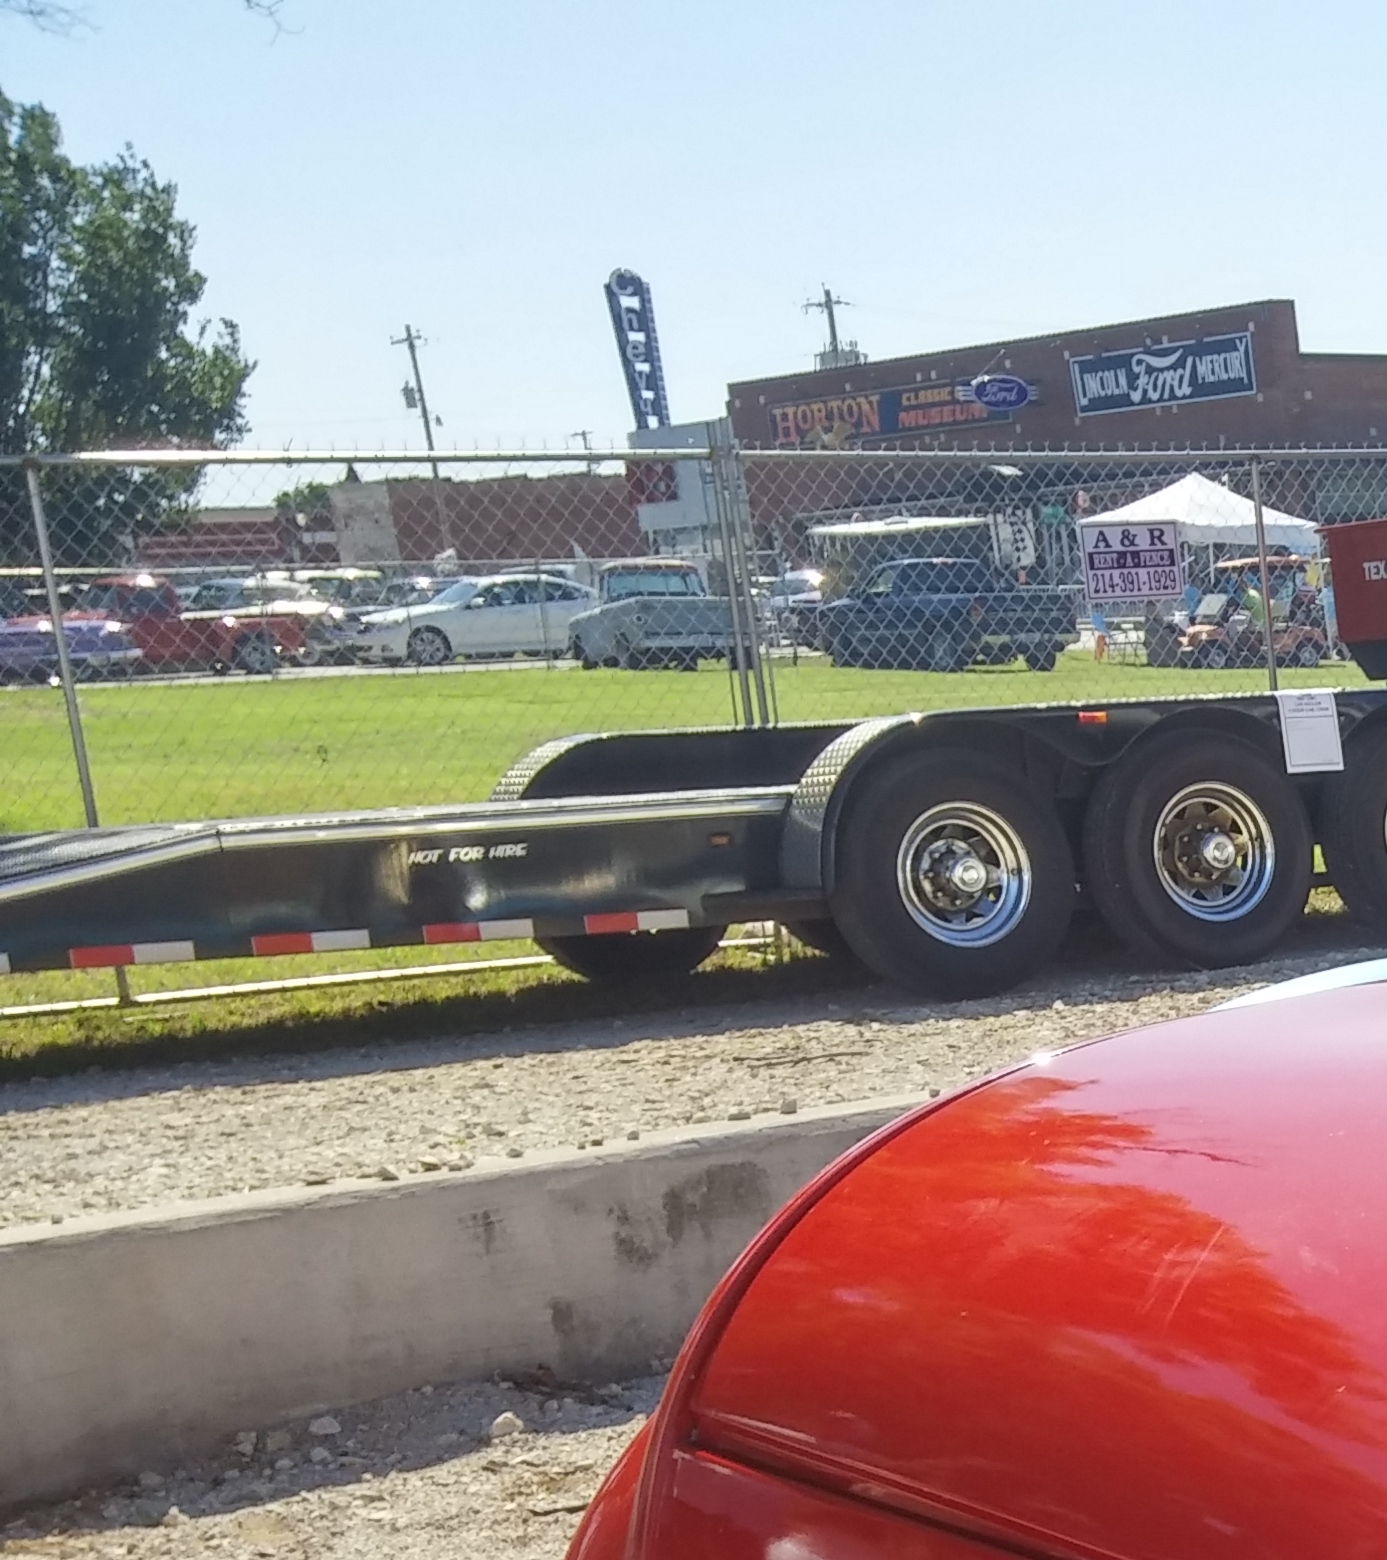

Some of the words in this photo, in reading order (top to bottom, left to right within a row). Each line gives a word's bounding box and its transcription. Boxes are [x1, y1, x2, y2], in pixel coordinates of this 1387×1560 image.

[1073, 362, 1130, 406] LINCOLN
[1128, 348, 1194, 404] Ford
[1195, 337, 1249, 385] MERCURY
[982, 383, 1020, 403] Ford
[771, 394, 881, 444] HORTON
[1092, 530, 1113, 549] A
[1120, 528, 1140, 548] &
[1147, 527, 1169, 547] R
[1091, 569, 1178, 596] 214-391-1929
[408, 848, 445, 865] NOT
[448, 845, 486, 863] FOR
[488, 842, 530, 860] HIRE
